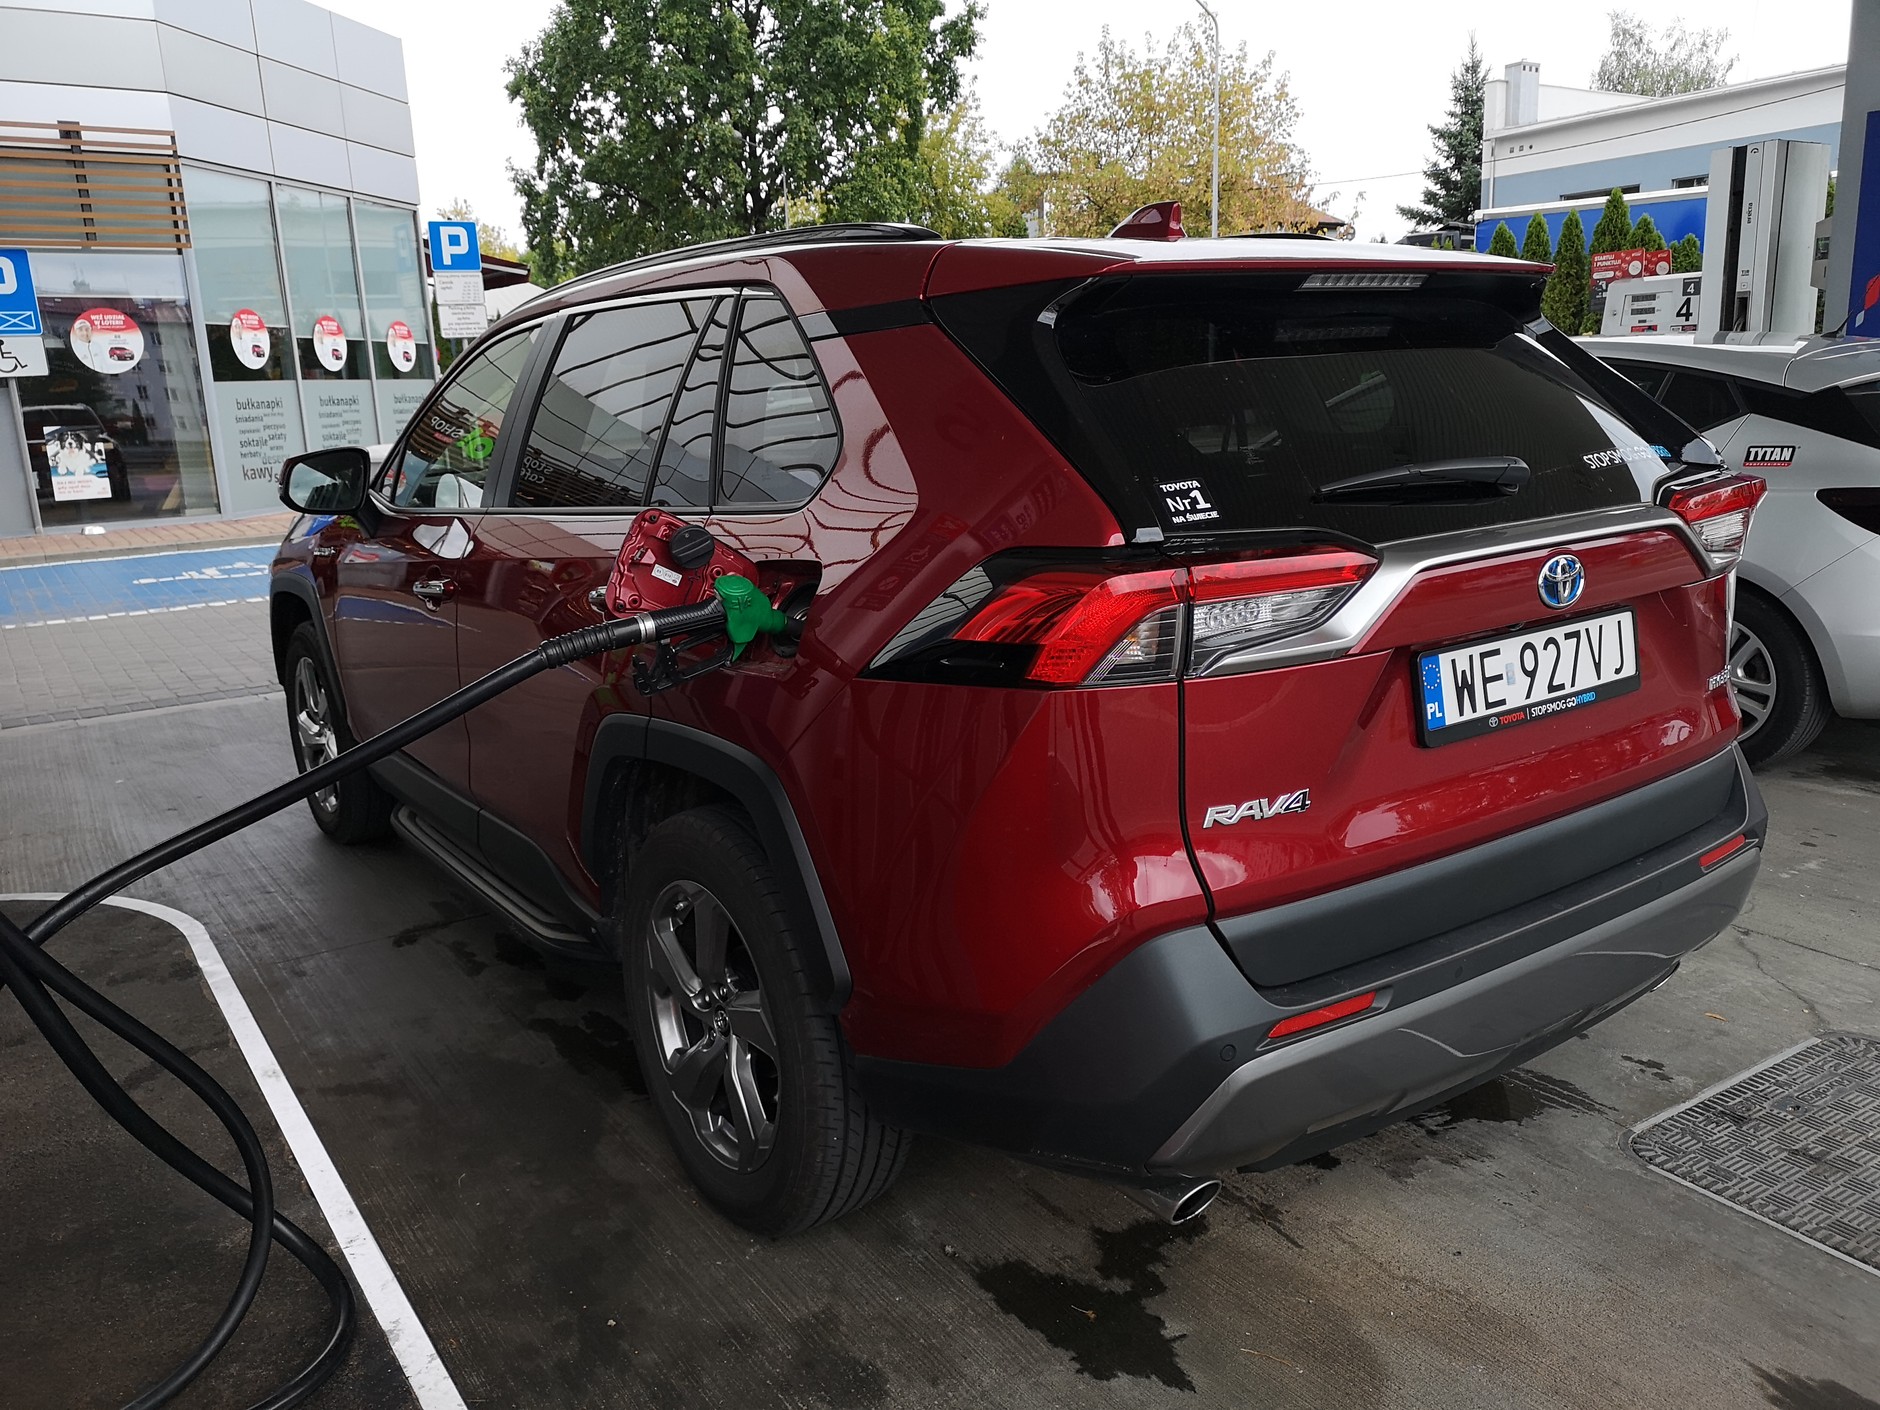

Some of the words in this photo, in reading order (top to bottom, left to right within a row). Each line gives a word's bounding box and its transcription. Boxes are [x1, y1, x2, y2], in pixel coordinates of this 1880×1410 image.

[439, 226, 469, 265] P
[1686, 283, 1695, 294] 4
[1676, 297, 1693, 322] 4
[235, 397, 283, 411] bułkanapki
[1749, 447, 1793, 461] TYTAN
[242, 464, 273, 483] kawy
[1159, 480, 1201, 493] TOYOTA
[1171, 515, 1187, 524] NA
[1186, 510, 1220, 522] ŚWIECIE
[1451, 648, 1507, 717] WE
[1519, 620, 1624, 700] 927VJ
[1427, 703, 1443, 720] PL
[1500, 711, 1525, 725] TOYOTA
[1202, 788, 1311, 829] RAV4
